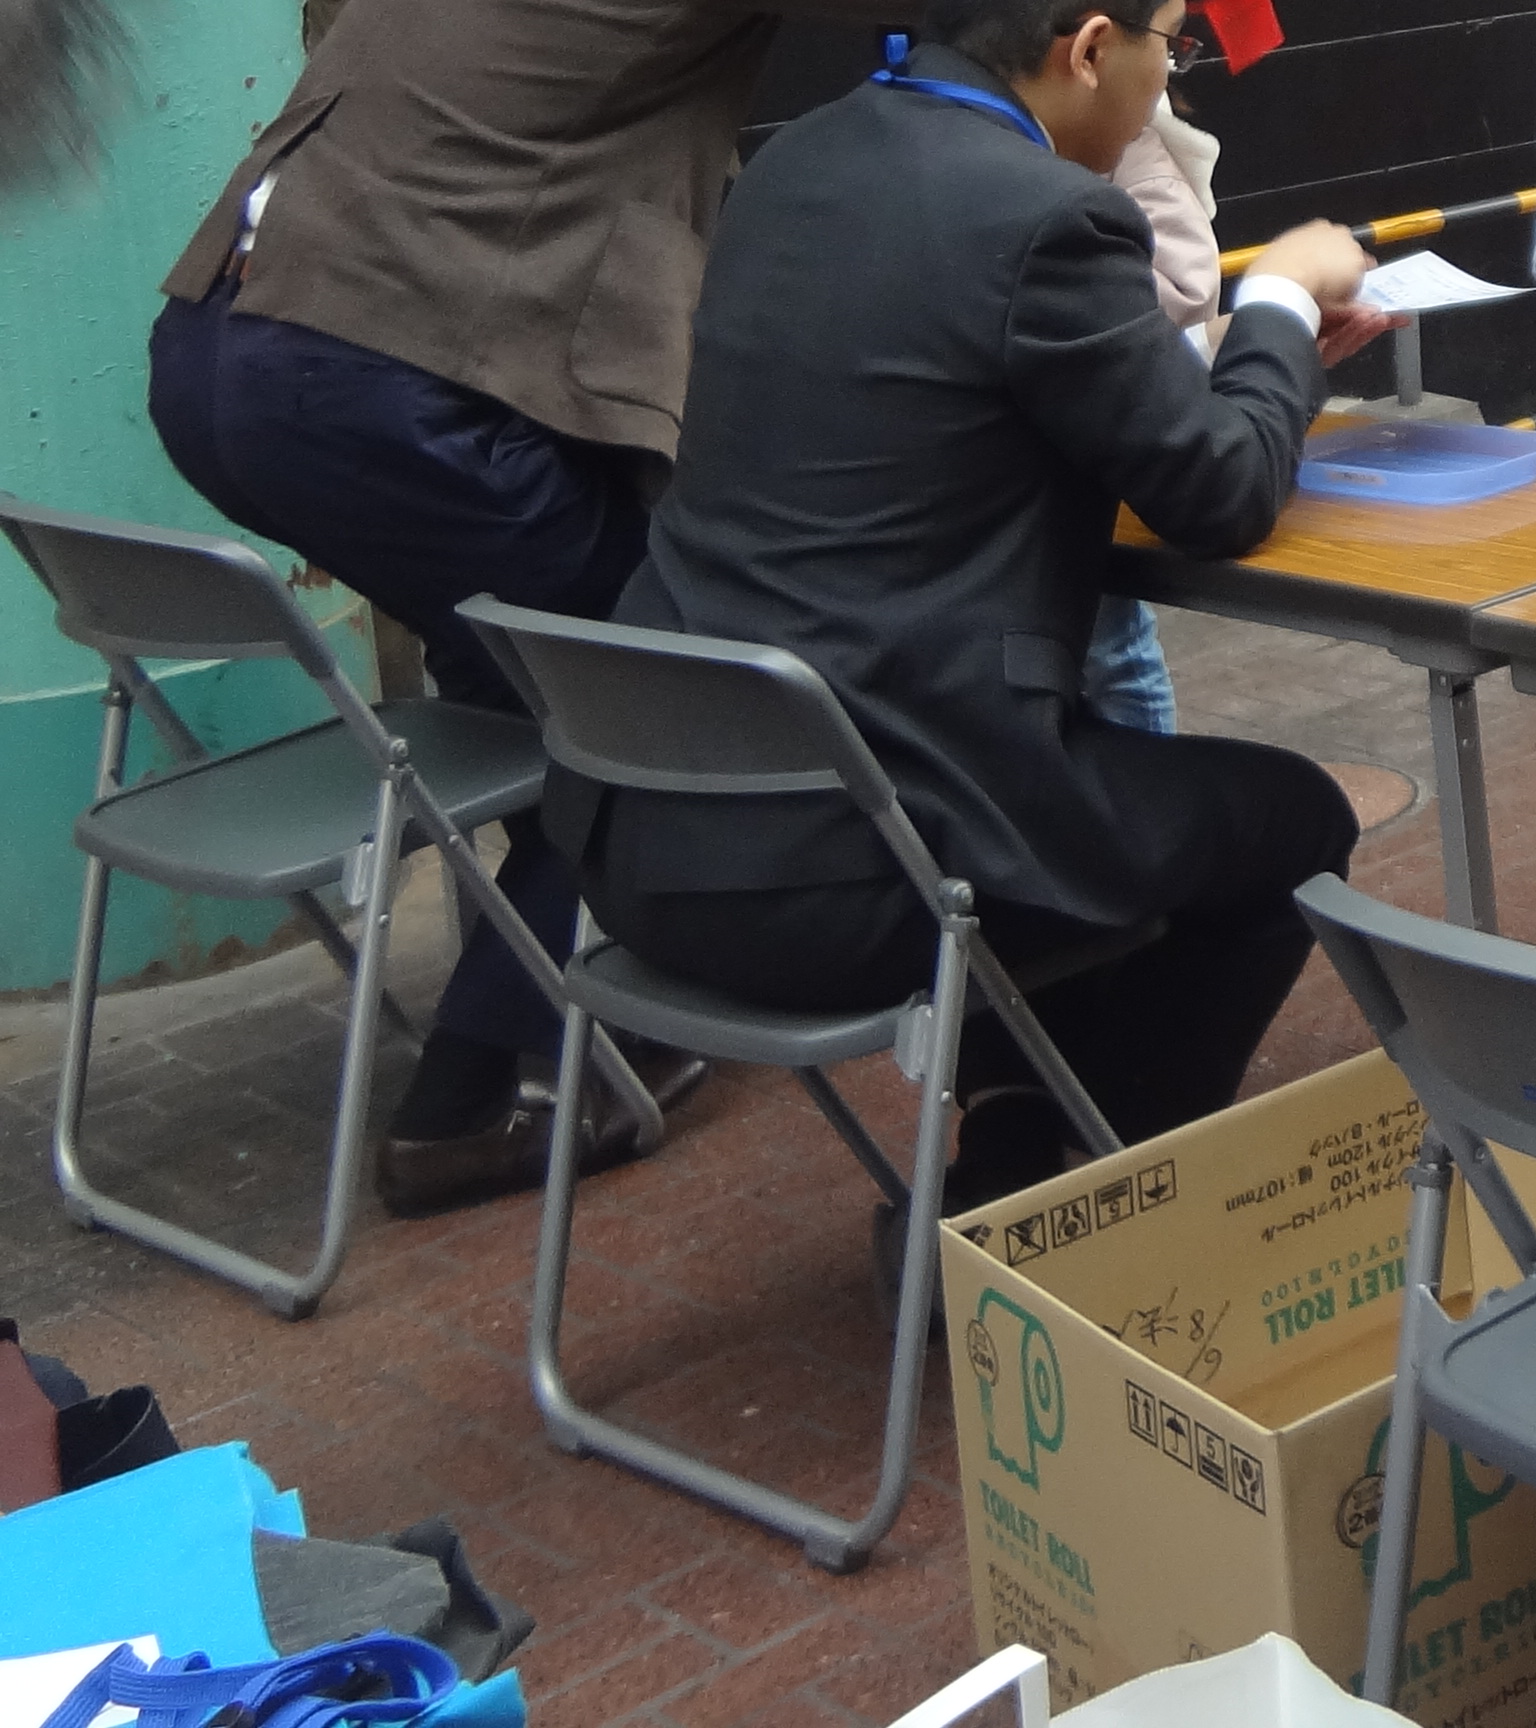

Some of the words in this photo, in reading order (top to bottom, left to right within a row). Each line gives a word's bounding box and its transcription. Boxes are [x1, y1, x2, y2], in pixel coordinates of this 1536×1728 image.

[1330, 1167, 1362, 1192] 100
[1347, 1256, 1407, 1310] ILET
[1263, 1286, 1336, 1345] ROLL
[979, 1478, 1039, 1553] TOILET
[1046, 1530, 1096, 1597] ROLL
